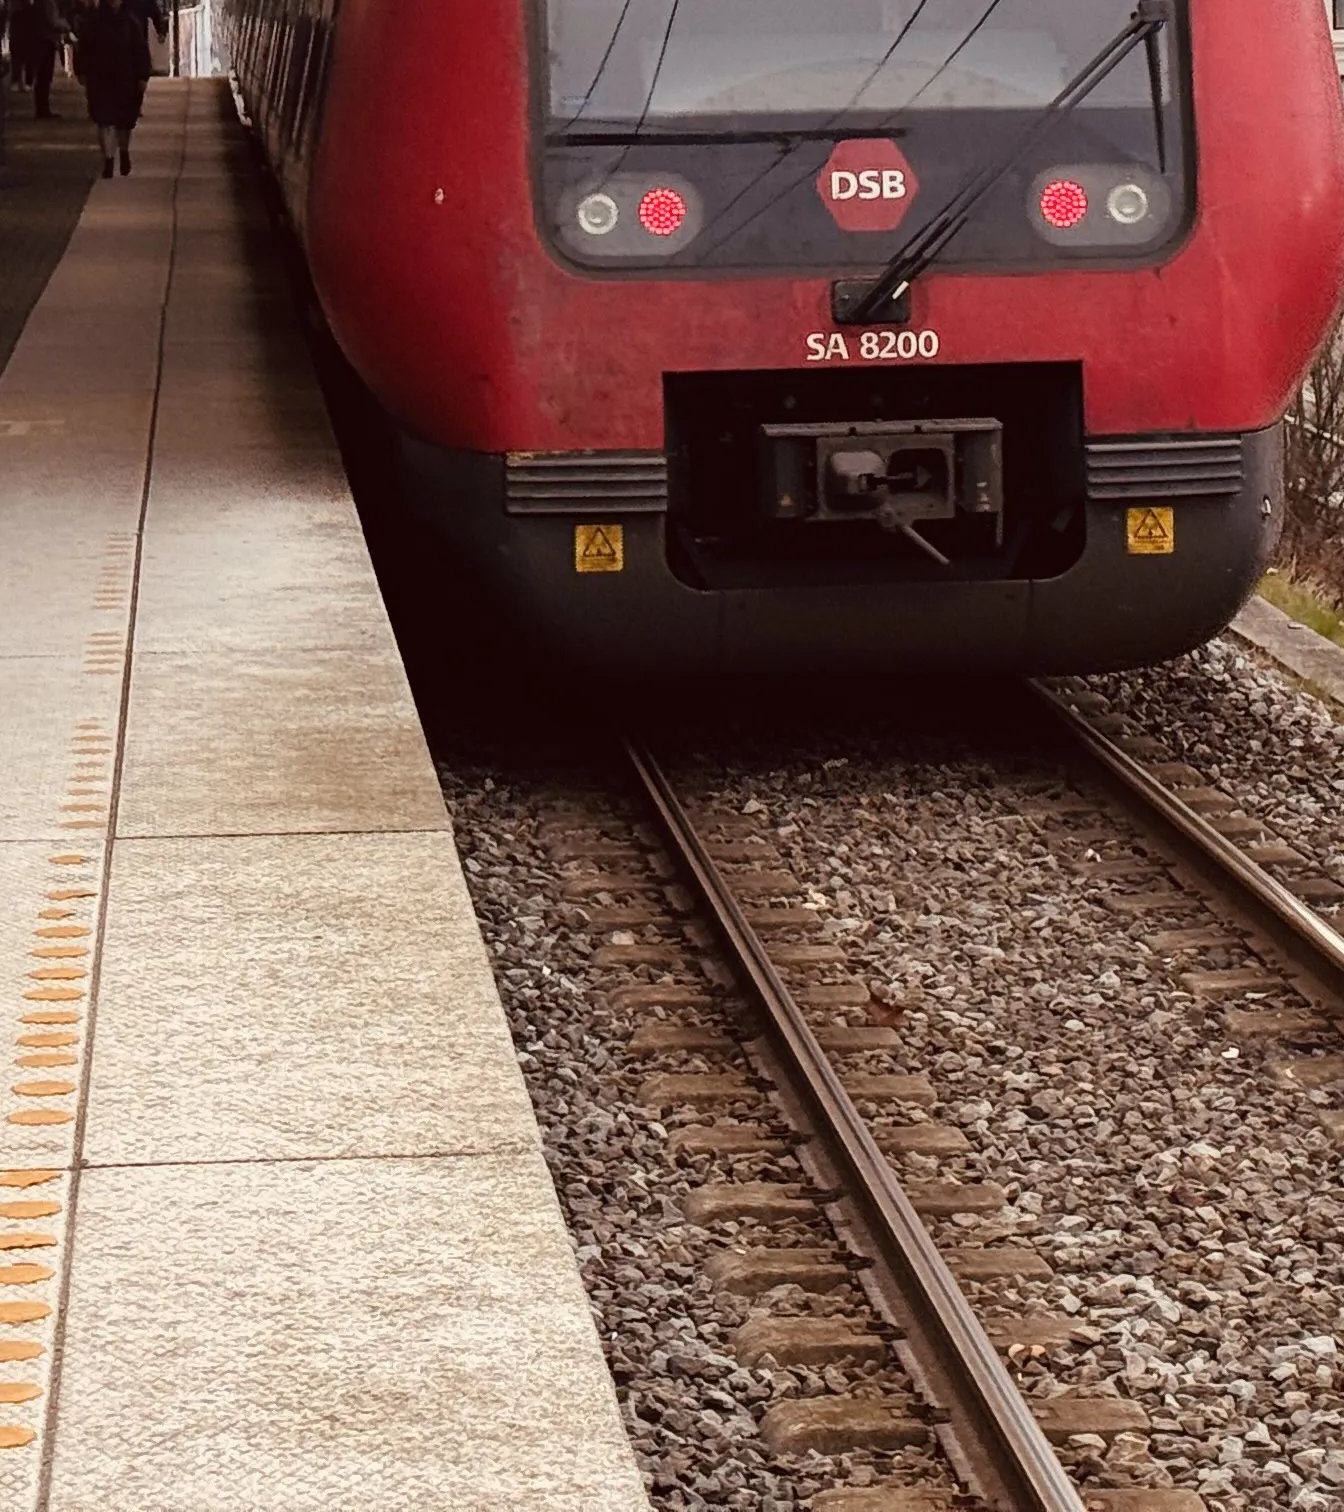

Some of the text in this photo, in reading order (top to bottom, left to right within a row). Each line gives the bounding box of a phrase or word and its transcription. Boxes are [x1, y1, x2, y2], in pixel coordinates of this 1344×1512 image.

[831, 170, 906, 200] DSB
[806, 330, 939, 360] SA 8200
